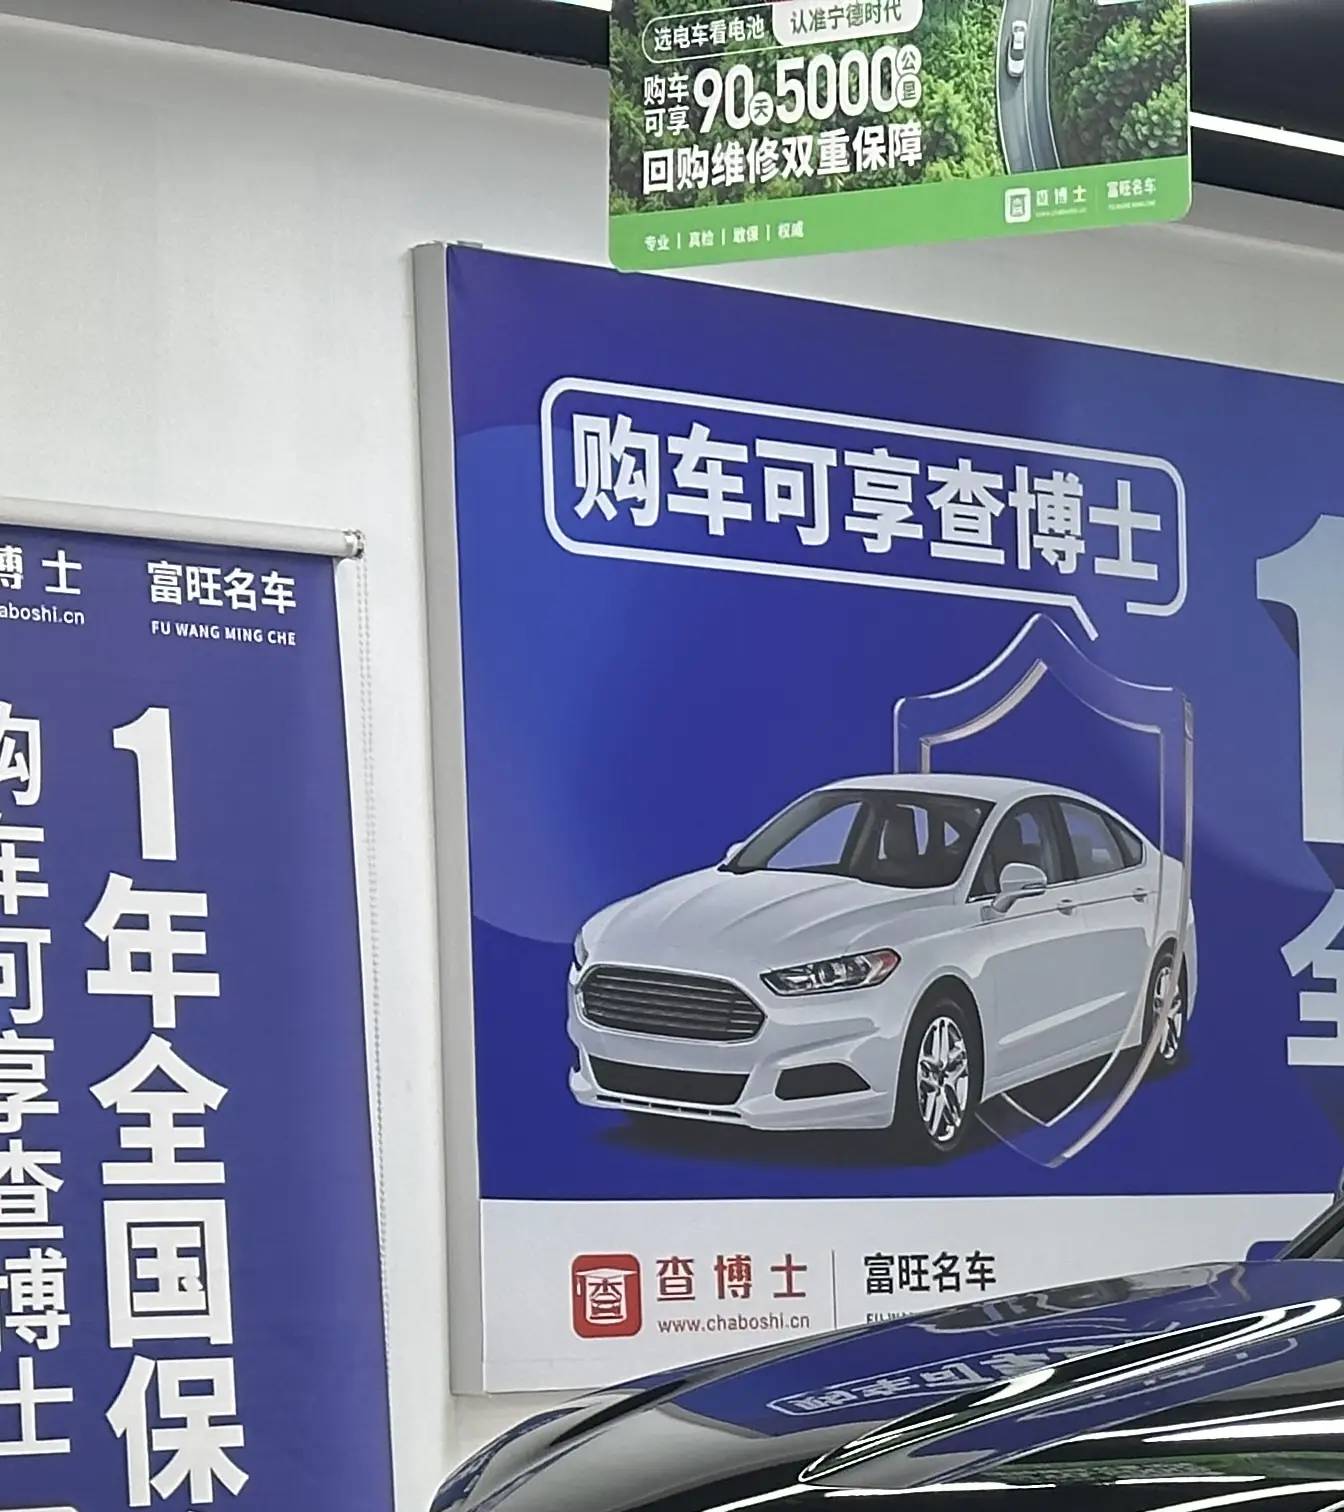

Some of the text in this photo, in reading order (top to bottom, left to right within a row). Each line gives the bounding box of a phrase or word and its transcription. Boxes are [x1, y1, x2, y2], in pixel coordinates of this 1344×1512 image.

[644, 72, 689, 105] 购车
[644, 107, 690, 137] 可享
[643, 120, 923, 195] 回购维修双重保障
[573, 413, 1161, 582] 购车可享查博士
[147, 560, 297, 614] 富旺名车
[151, 620, 296, 646] FU WANG MING CHE
[656, 1253, 808, 1302] 查博士
[864, 1250, 996, 1295] 富旺名车
[657, 1312, 811, 1333] www.chaboshi.cn
